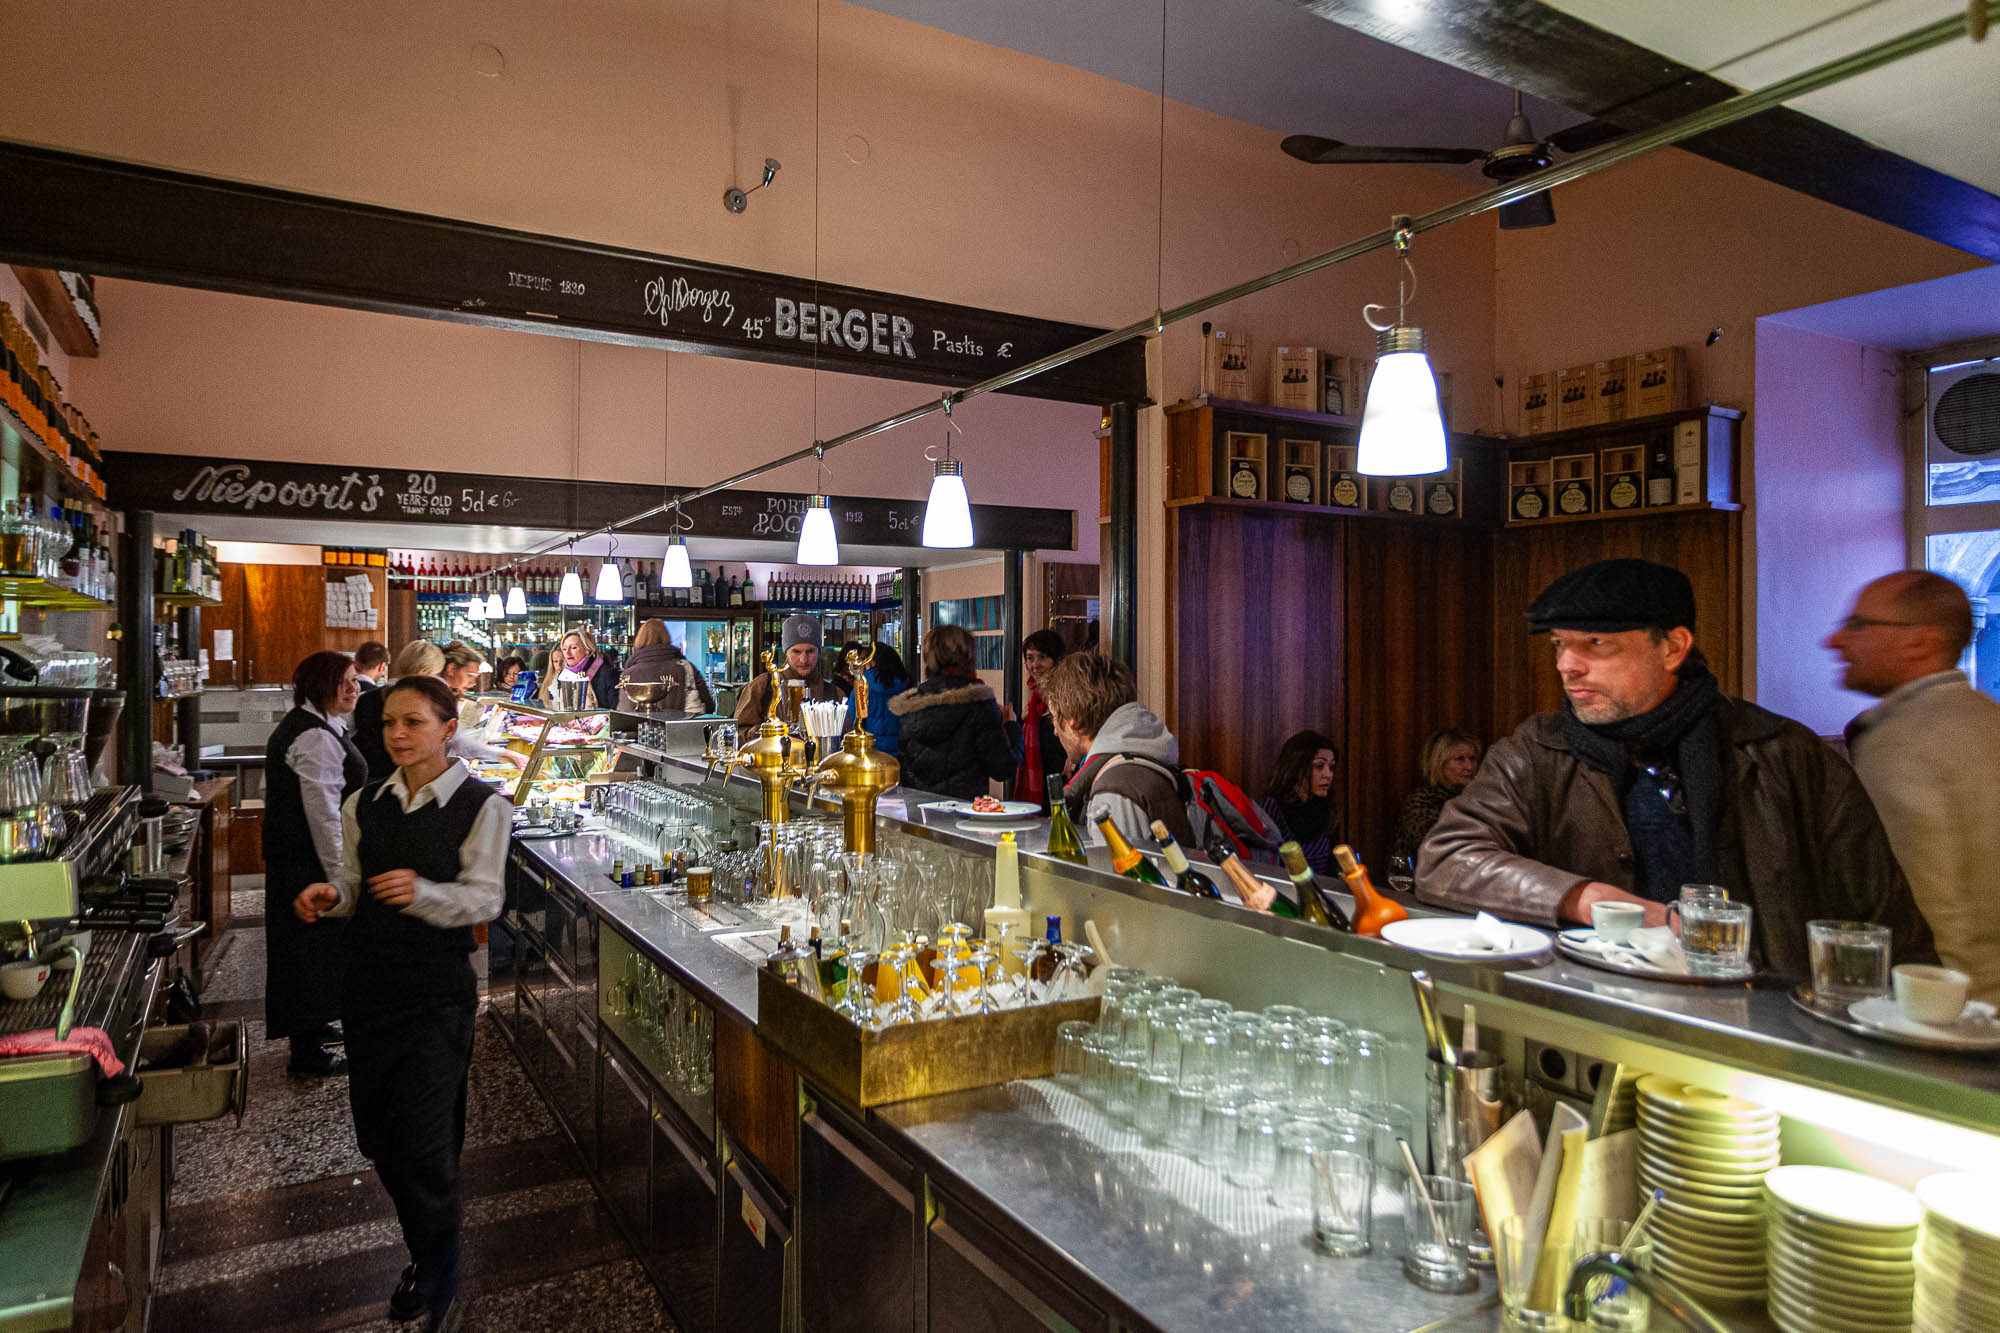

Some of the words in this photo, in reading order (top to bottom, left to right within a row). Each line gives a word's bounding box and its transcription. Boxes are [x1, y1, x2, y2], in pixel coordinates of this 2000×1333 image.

[508, 272, 552, 292] DEPUIS
[559, 280, 585, 296] 1830
[775, 297, 917, 359] BERGER
[932, 329, 984, 357] Pastis
[172, 464, 384, 512] Niepoort's
[407, 473, 437, 495] 20
[396, 493, 429, 507] YEARS
[431, 495, 452, 507] OLD
[430, 507, 451, 515] PORT
[766, 497, 806, 514] PORT
